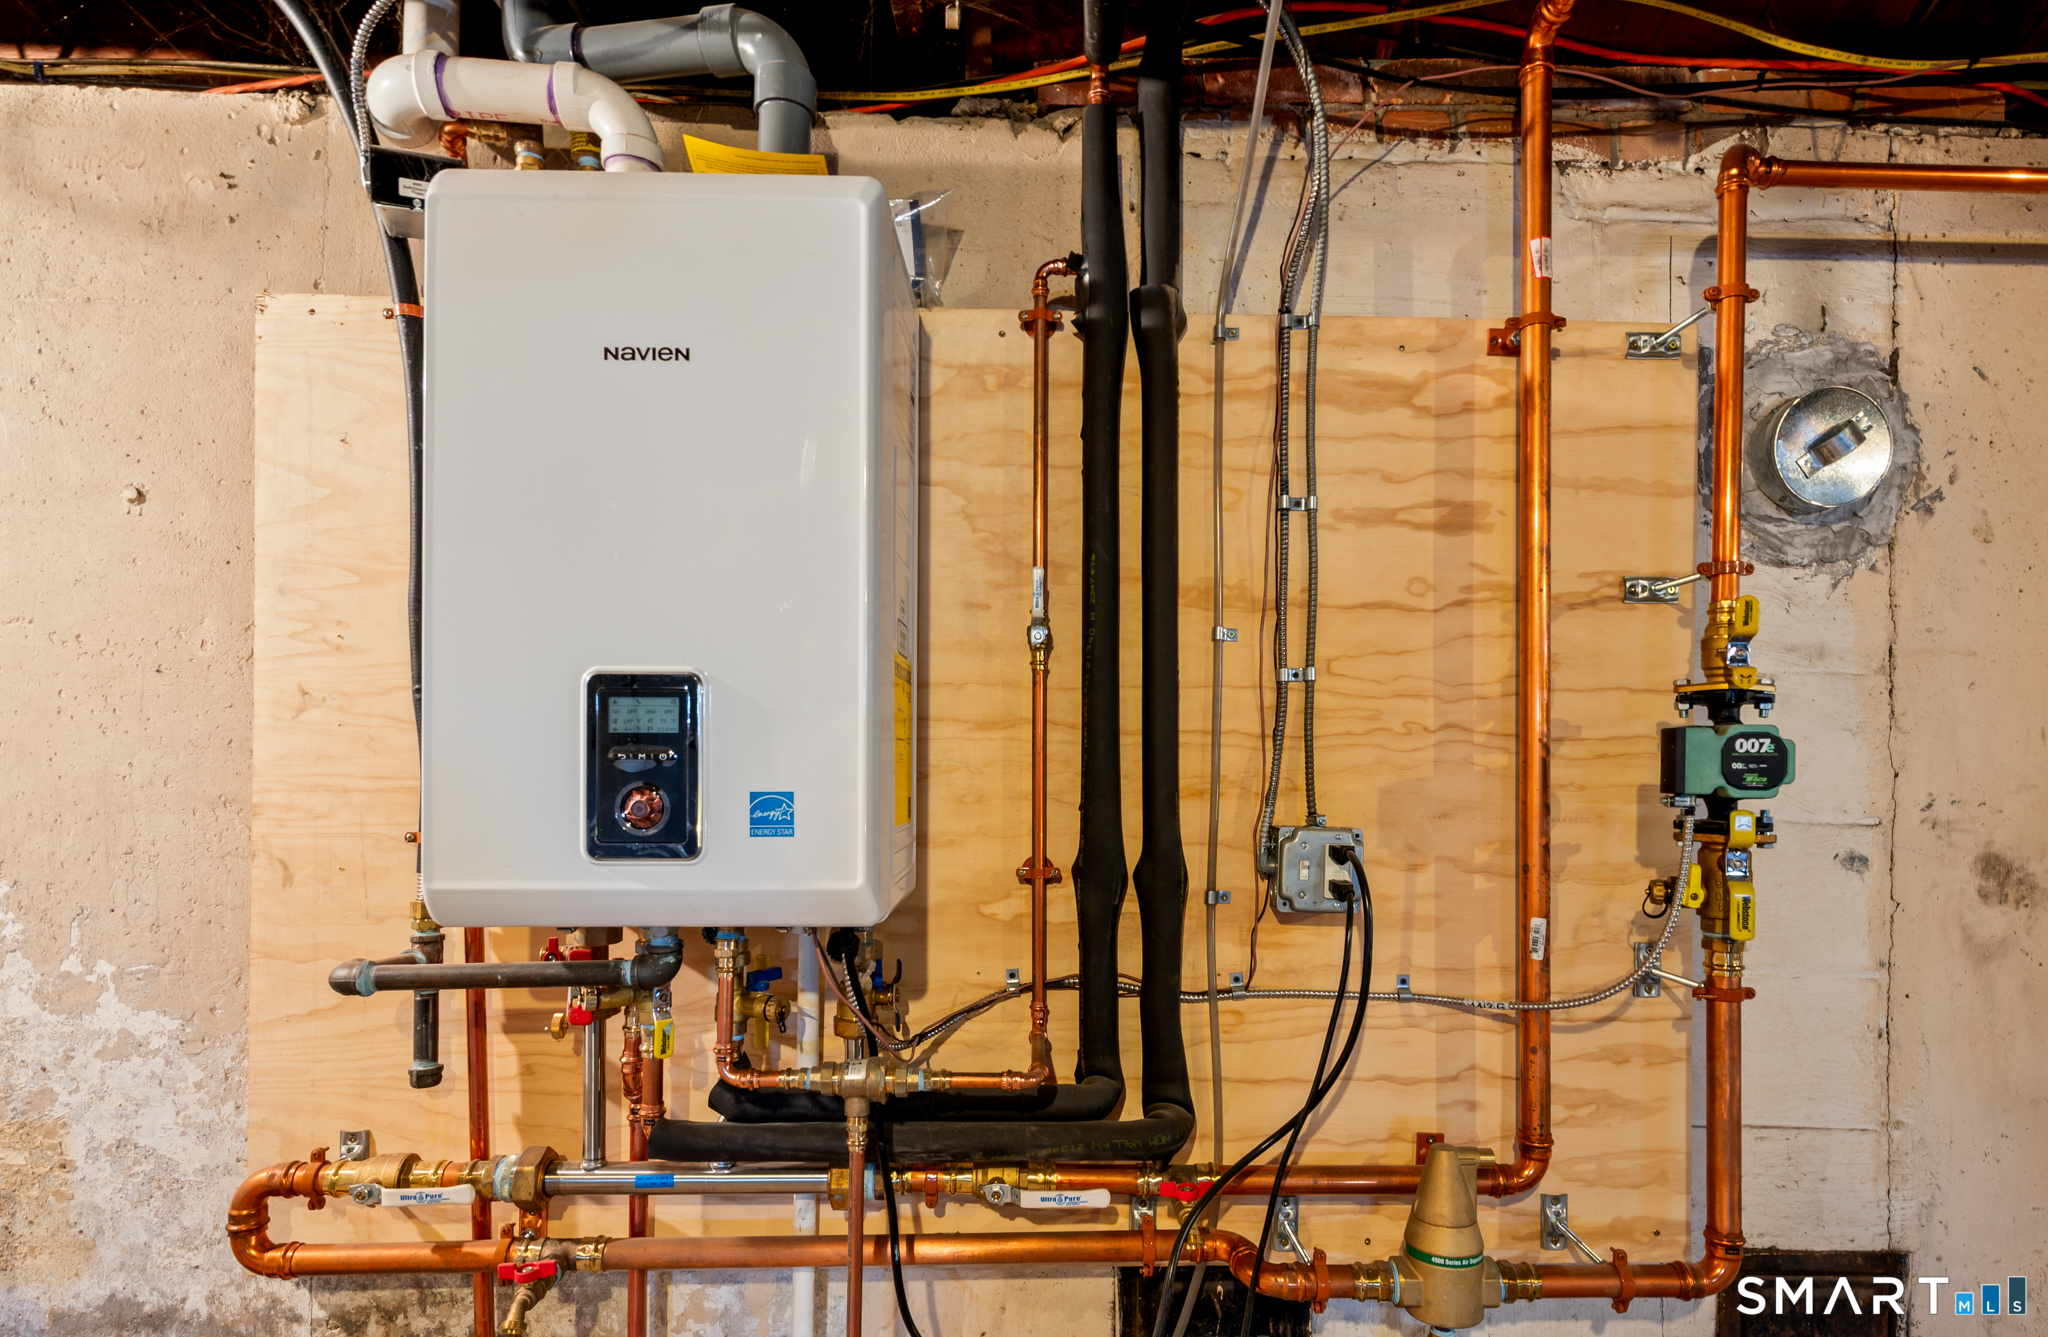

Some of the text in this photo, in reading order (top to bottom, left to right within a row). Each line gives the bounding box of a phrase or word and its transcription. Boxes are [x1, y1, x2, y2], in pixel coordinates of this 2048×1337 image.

[751, 828, 794, 836] ENERGY STAR
[1742, 896, 1751, 930] Webstone
[1113, 1138, 1143, 1150] WALL
[1431, 1256, 1445, 1265] 4900
[1445, 1258, 1461, 1266] Series
